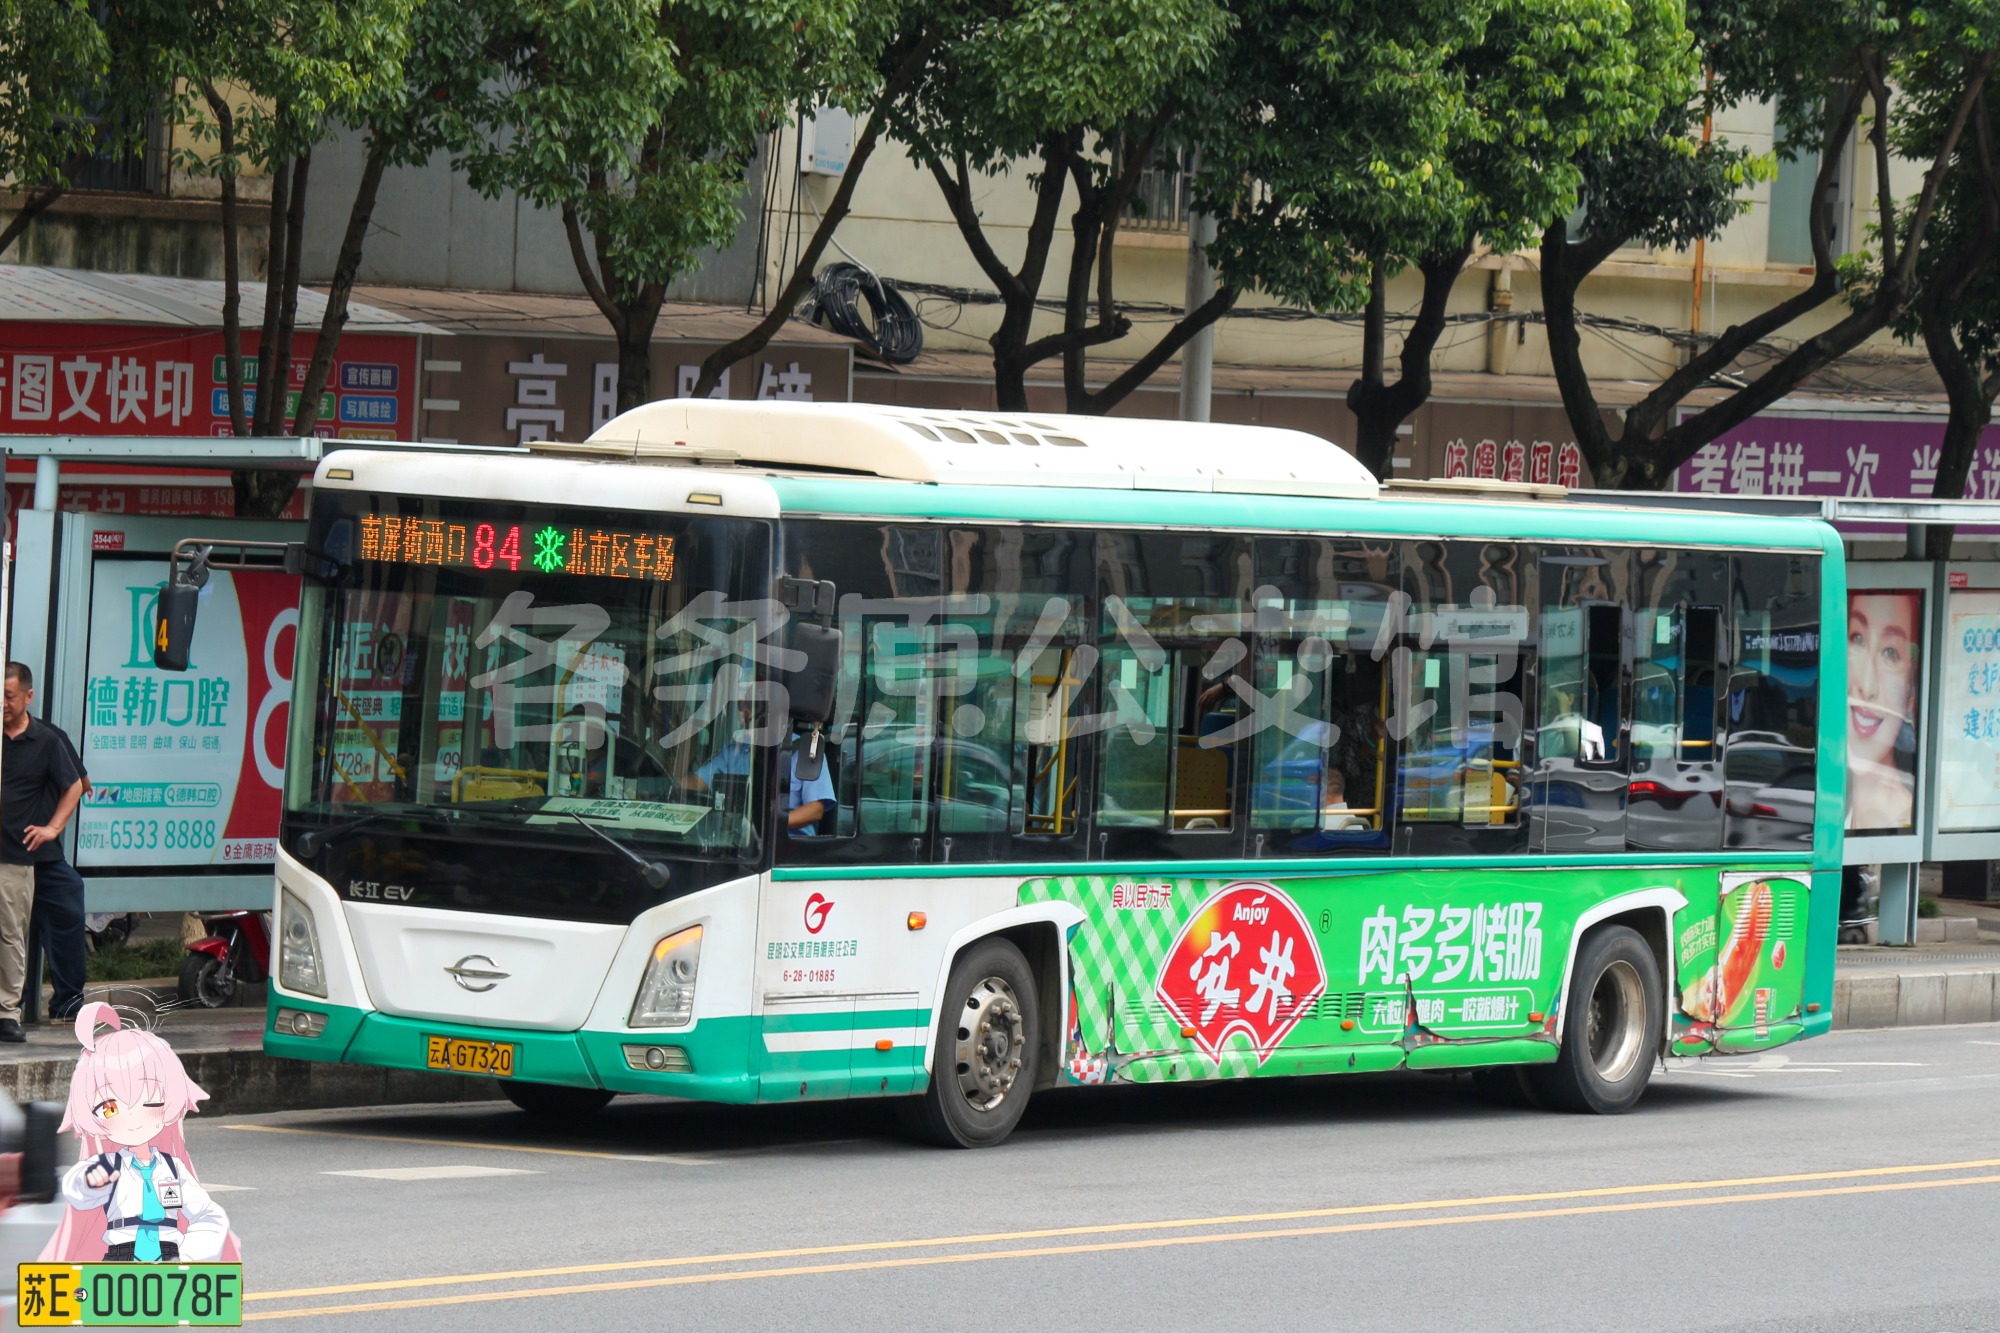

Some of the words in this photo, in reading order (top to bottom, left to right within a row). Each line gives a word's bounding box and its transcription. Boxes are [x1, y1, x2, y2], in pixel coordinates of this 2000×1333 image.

[0, 354, 194, 427] 图文快印
[347, 367, 392, 387] 宣传画册
[346, 400, 391, 419] 写真喷绘
[1691, 442, 1879, 497] 考编拼一次
[361, 513, 466, 565] 南屏街西口
[472, 524, 522, 571] 84
[566, 528, 675, 581] 北市区车场
[157, 618, 168, 652] 4
[1968, 663, 2000, 695] 爱护
[88, 676, 230, 727] 德韩口腔
[1963, 707, 2000, 740] 建设
[130, 735, 147, 749] 昆明
[153, 735, 173, 749] 曲靖
[179, 736, 196, 749] 保山
[123, 787, 163, 803] 地图搜索
[176, 787, 217, 802] 德韩口腔
[164, 820, 216, 849] 8888
[383, 885, 415, 901] EV
[1112, 884, 1173, 909] 食以民为天
[1233, 895, 1270, 925] Anjoy
[767, 940, 858, 960] 昆明公交集团有限责任公司
[1358, 902, 1543, 986] 肉多多烤肠
[783, 969, 835, 983] 6-28-01885
[1189, 930, 1296, 1027] 安井
